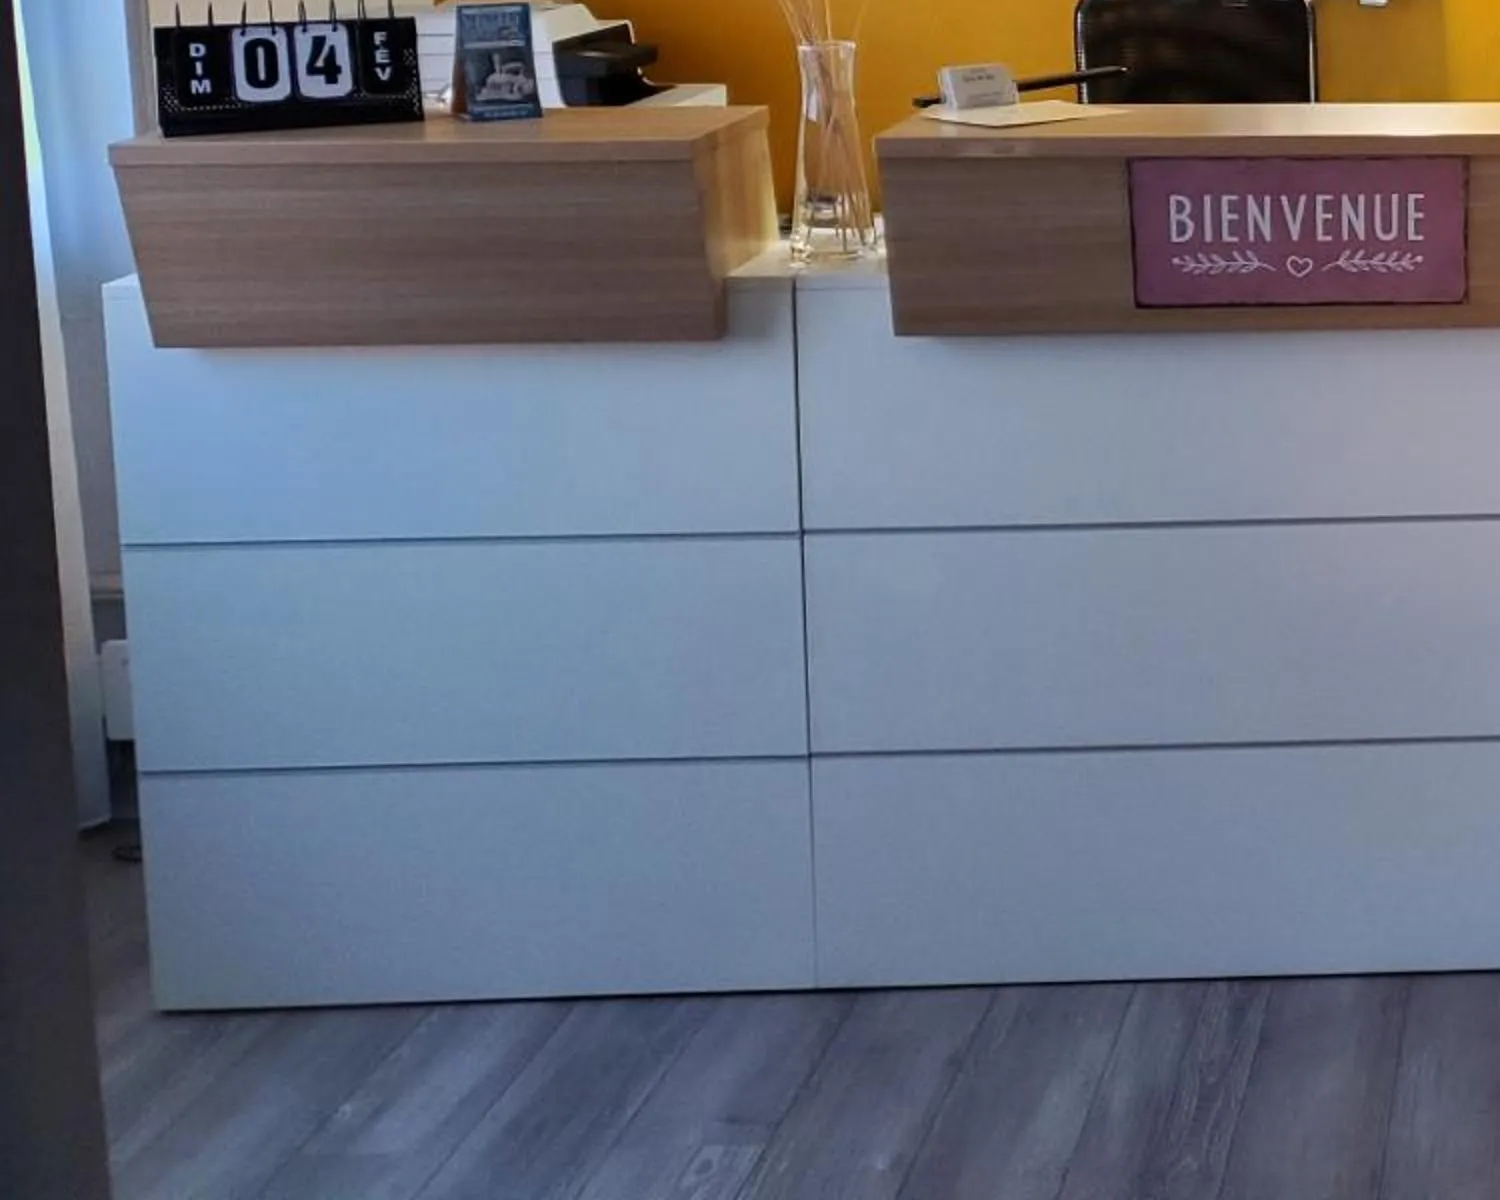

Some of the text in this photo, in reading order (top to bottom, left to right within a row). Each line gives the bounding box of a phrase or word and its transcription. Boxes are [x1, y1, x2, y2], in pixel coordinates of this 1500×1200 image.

[188, 42, 212, 95] DIM
[243, 35, 343, 90] 04
[1168, 193, 1426, 244] BIENVENUE
